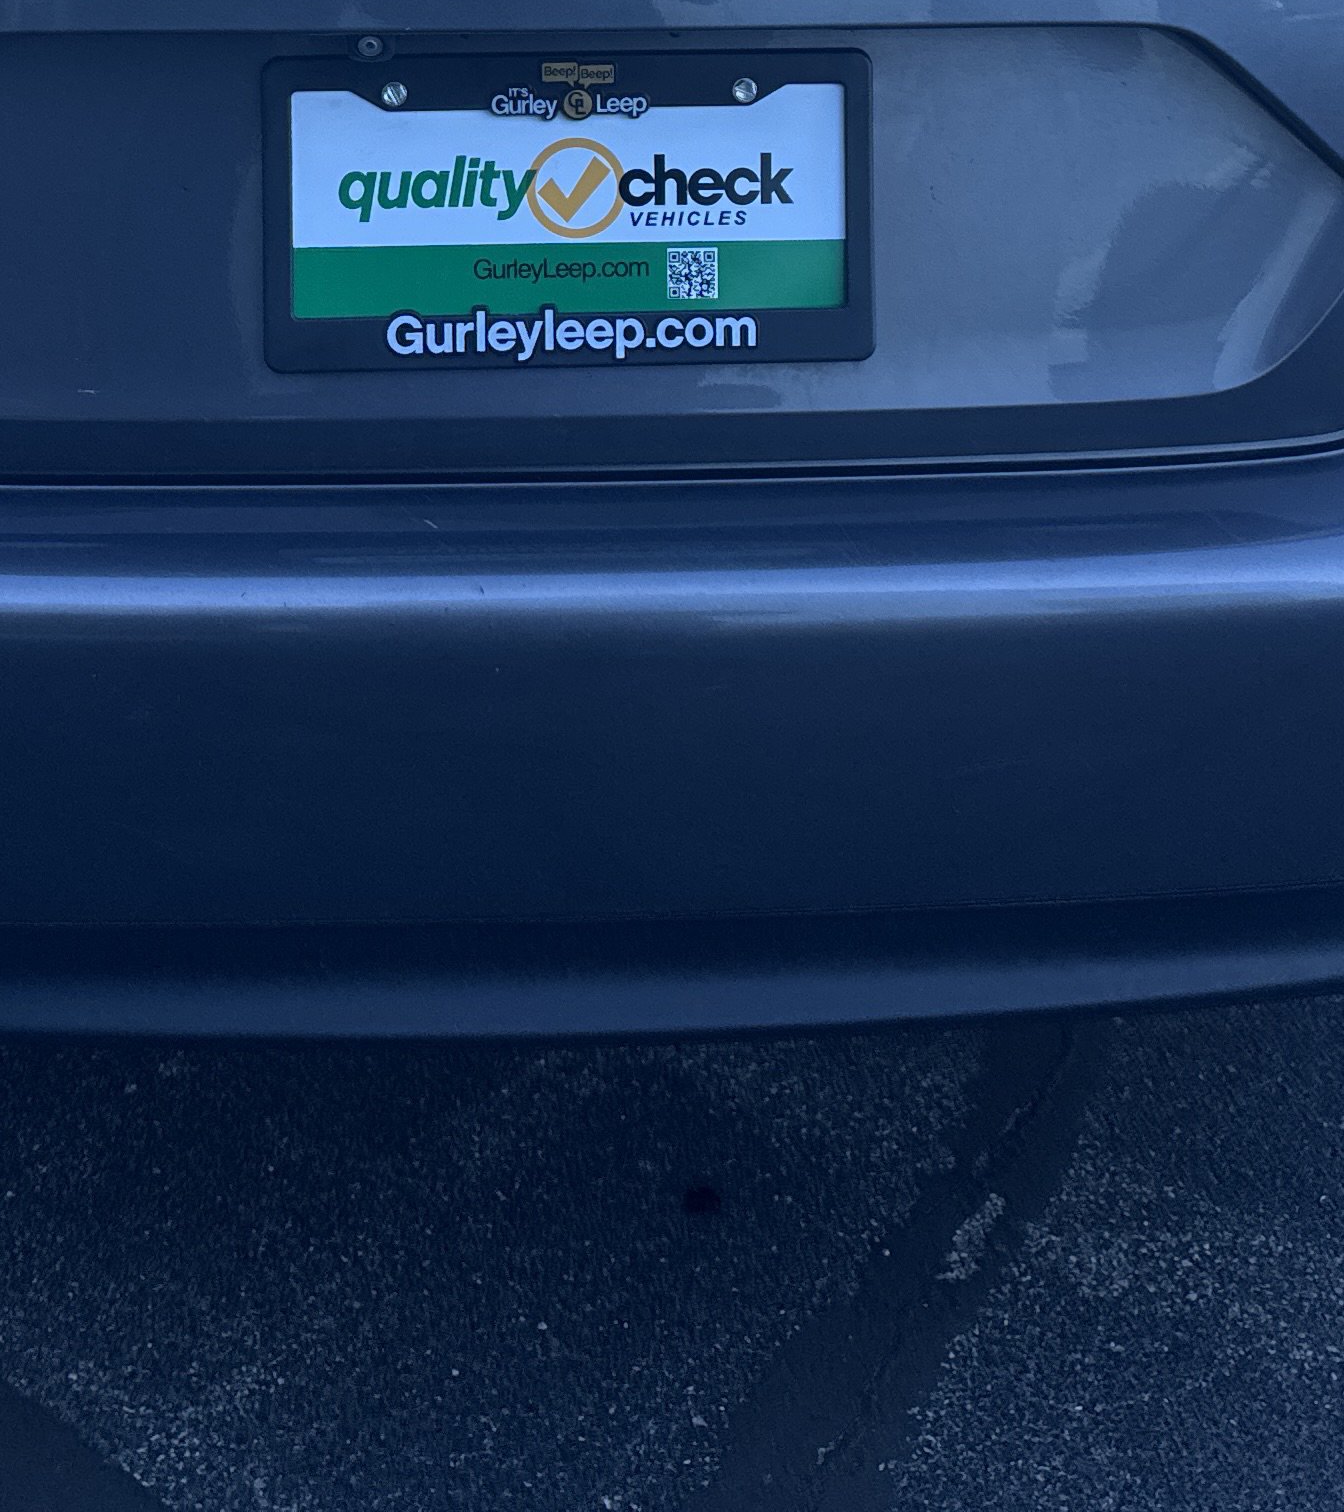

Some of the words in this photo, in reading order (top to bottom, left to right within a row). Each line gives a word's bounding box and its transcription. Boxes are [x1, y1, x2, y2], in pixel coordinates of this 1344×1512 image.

[544, 66, 576, 78] Beep!
[581, 68, 613, 80] Beep!
[491, 94, 558, 120] Gurley
[596, 94, 648, 117] Leep
[338, 155, 538, 223] quality
[618, 152, 794, 207] check
[630, 210, 747, 227] VEHICLES
[473, 258, 649, 285] GurleyLeep.com
[387, 309, 757, 362] Gurleyleep.com
